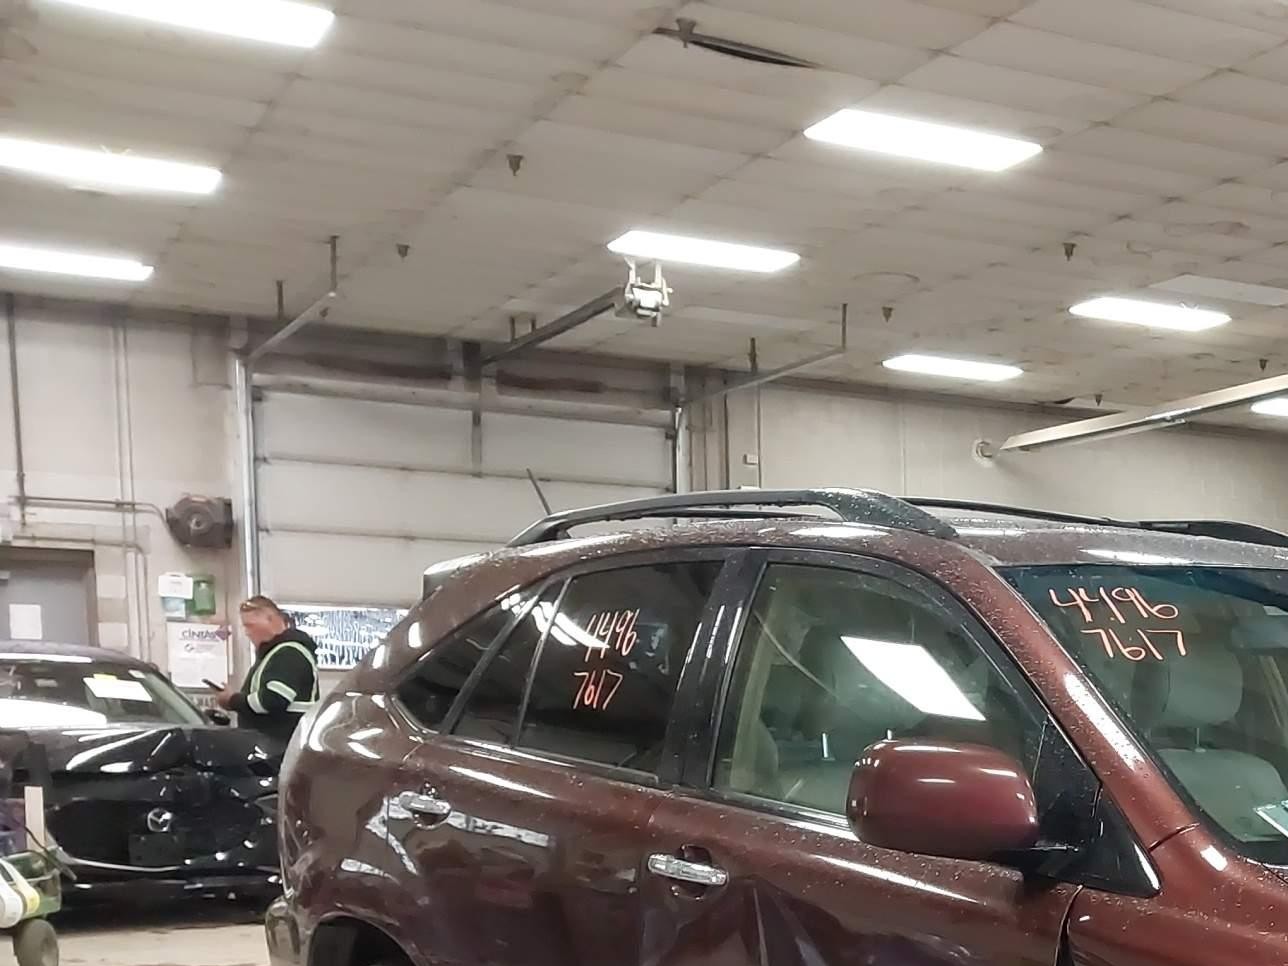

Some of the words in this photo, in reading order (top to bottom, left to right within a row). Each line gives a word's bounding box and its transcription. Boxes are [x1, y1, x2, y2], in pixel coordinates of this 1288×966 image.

[1049, 586, 1179, 624] 4496
[585, 608, 640, 662] 4496
[1080, 628, 1187, 661] 7617
[573, 669, 623, 710] 7617
